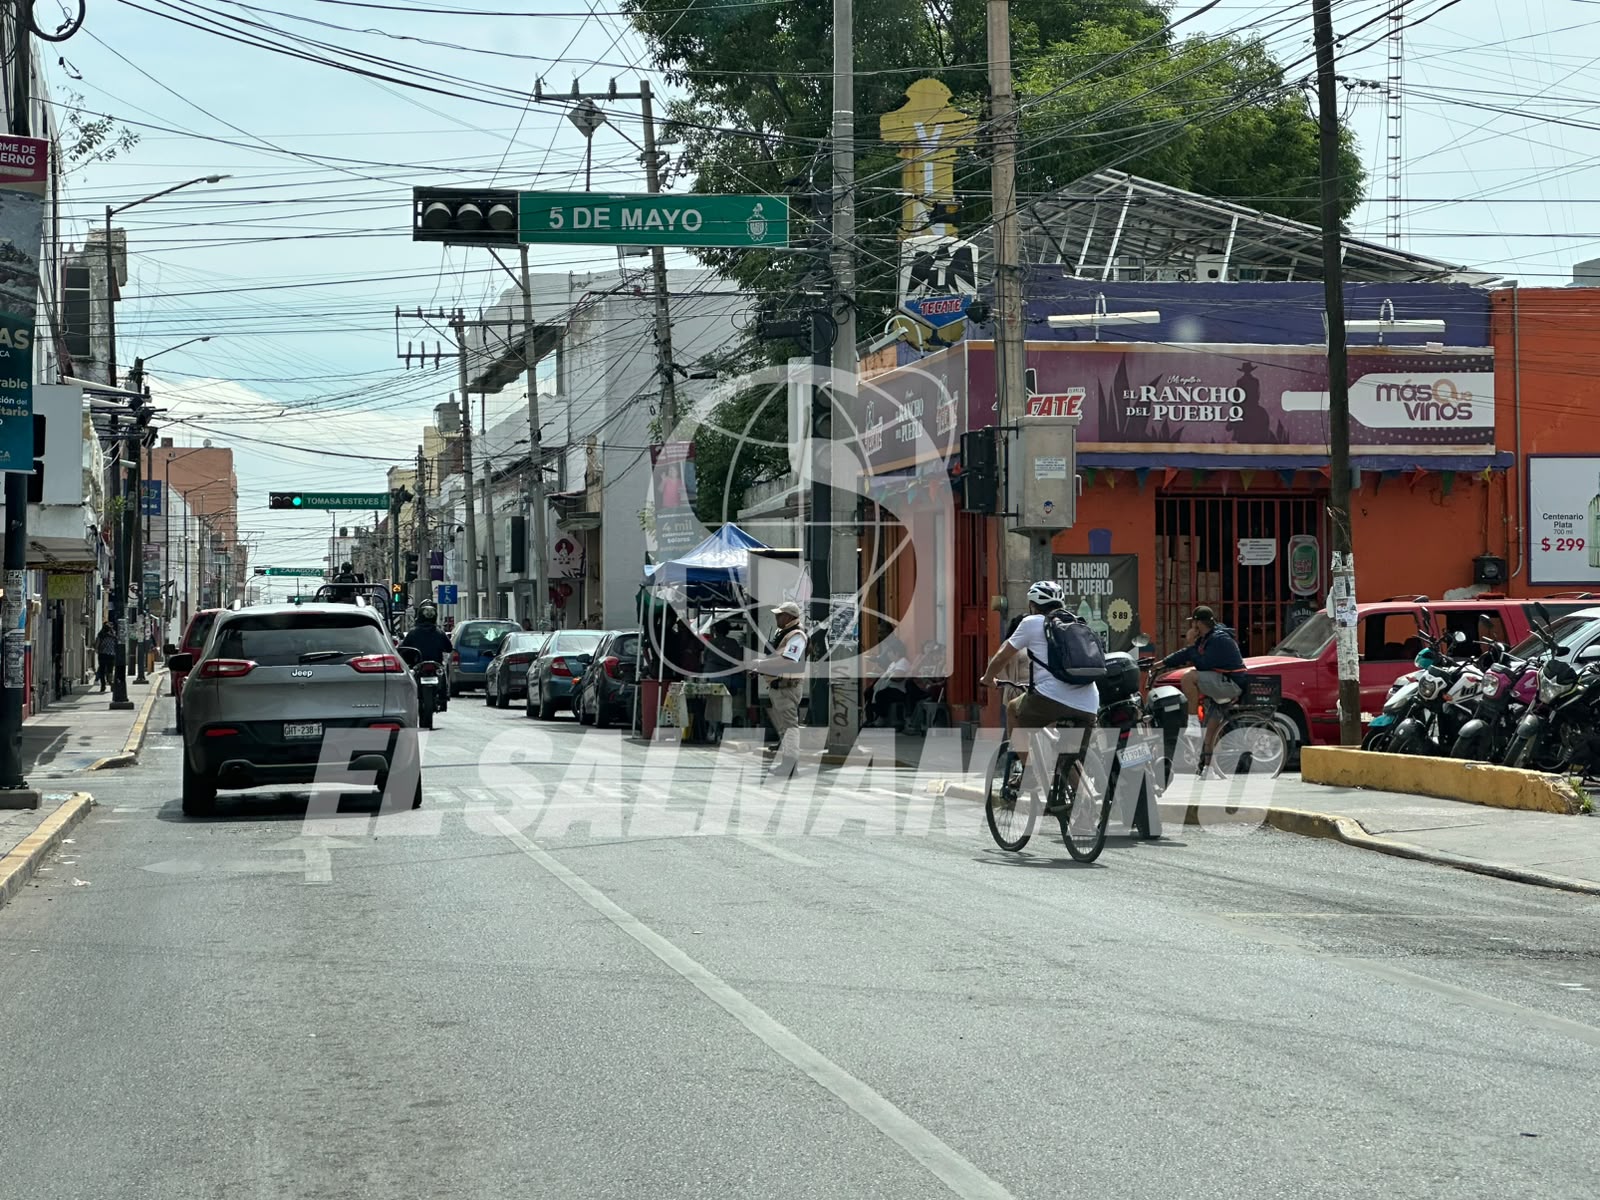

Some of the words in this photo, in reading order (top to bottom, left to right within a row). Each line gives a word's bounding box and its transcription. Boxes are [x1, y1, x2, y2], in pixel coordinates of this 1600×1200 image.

[21, 145, 36, 154] DE
[1, 153, 36, 165] ERNO
[549, 207, 564, 230] 5
[573, 207, 610, 230] DE
[621, 208, 702, 232] MAYO
[919, 300, 963, 315] TECATE
[1123, 390, 1138, 399] EL
[1139, 385, 1246, 404] RANCHO
[0, 406, 28, 417] tario
[1026, 394, 1085, 417] CATE
[1126, 407, 1150, 416] DEL
[1152, 405, 1244, 422] PUEBLO
[306, 497, 342, 505] TOMASA
[1542, 512, 1584, 520] Centenario
[1553, 521, 1573, 529] Plata
[1541, 537, 1551, 552] $
[1556, 538, 1585, 551] 299
[1057, 563, 1068, 578] EL
[1070, 563, 1110, 578] RANCHO
[1077, 580, 1113, 596] PUEBLO
[1118, 611, 1128, 619] 89
[291, 669, 313, 677] Jeep
